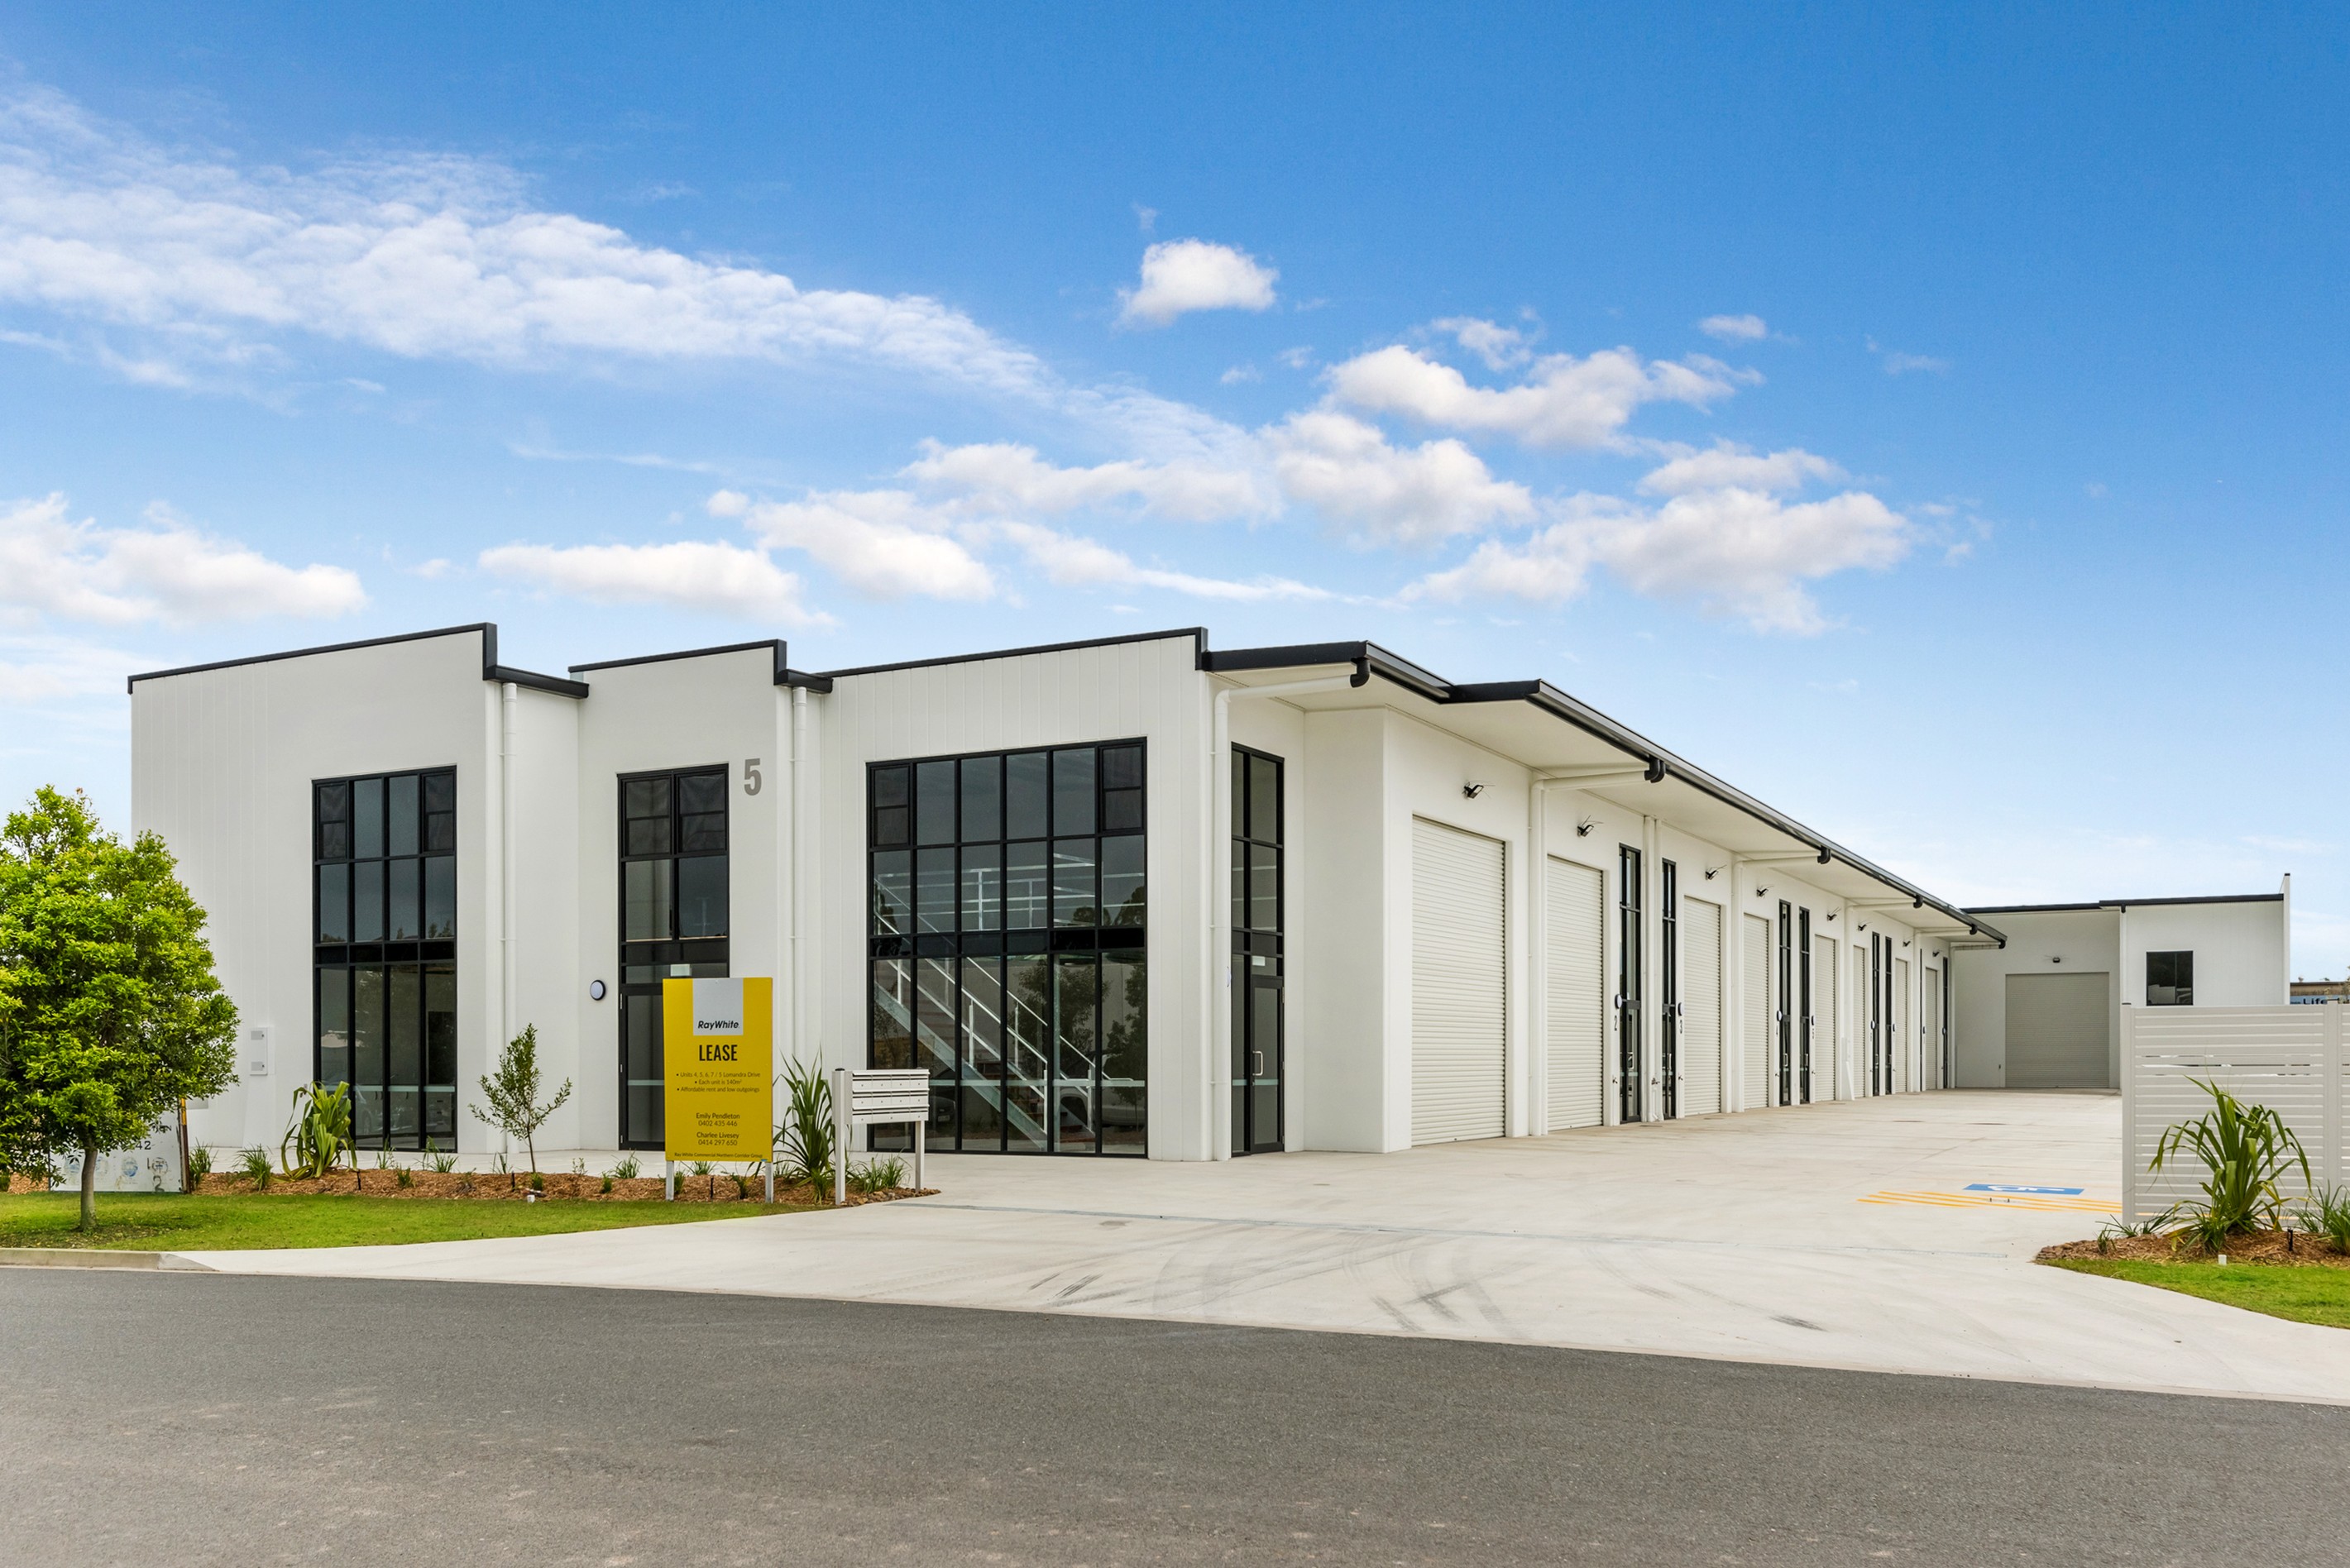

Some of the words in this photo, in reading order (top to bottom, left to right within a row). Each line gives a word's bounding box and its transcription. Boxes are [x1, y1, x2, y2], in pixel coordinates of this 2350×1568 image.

[744, 758, 762, 796] 5
[697, 1020, 739, 1030] RayWhite
[699, 1045, 738, 1061] LEASE
